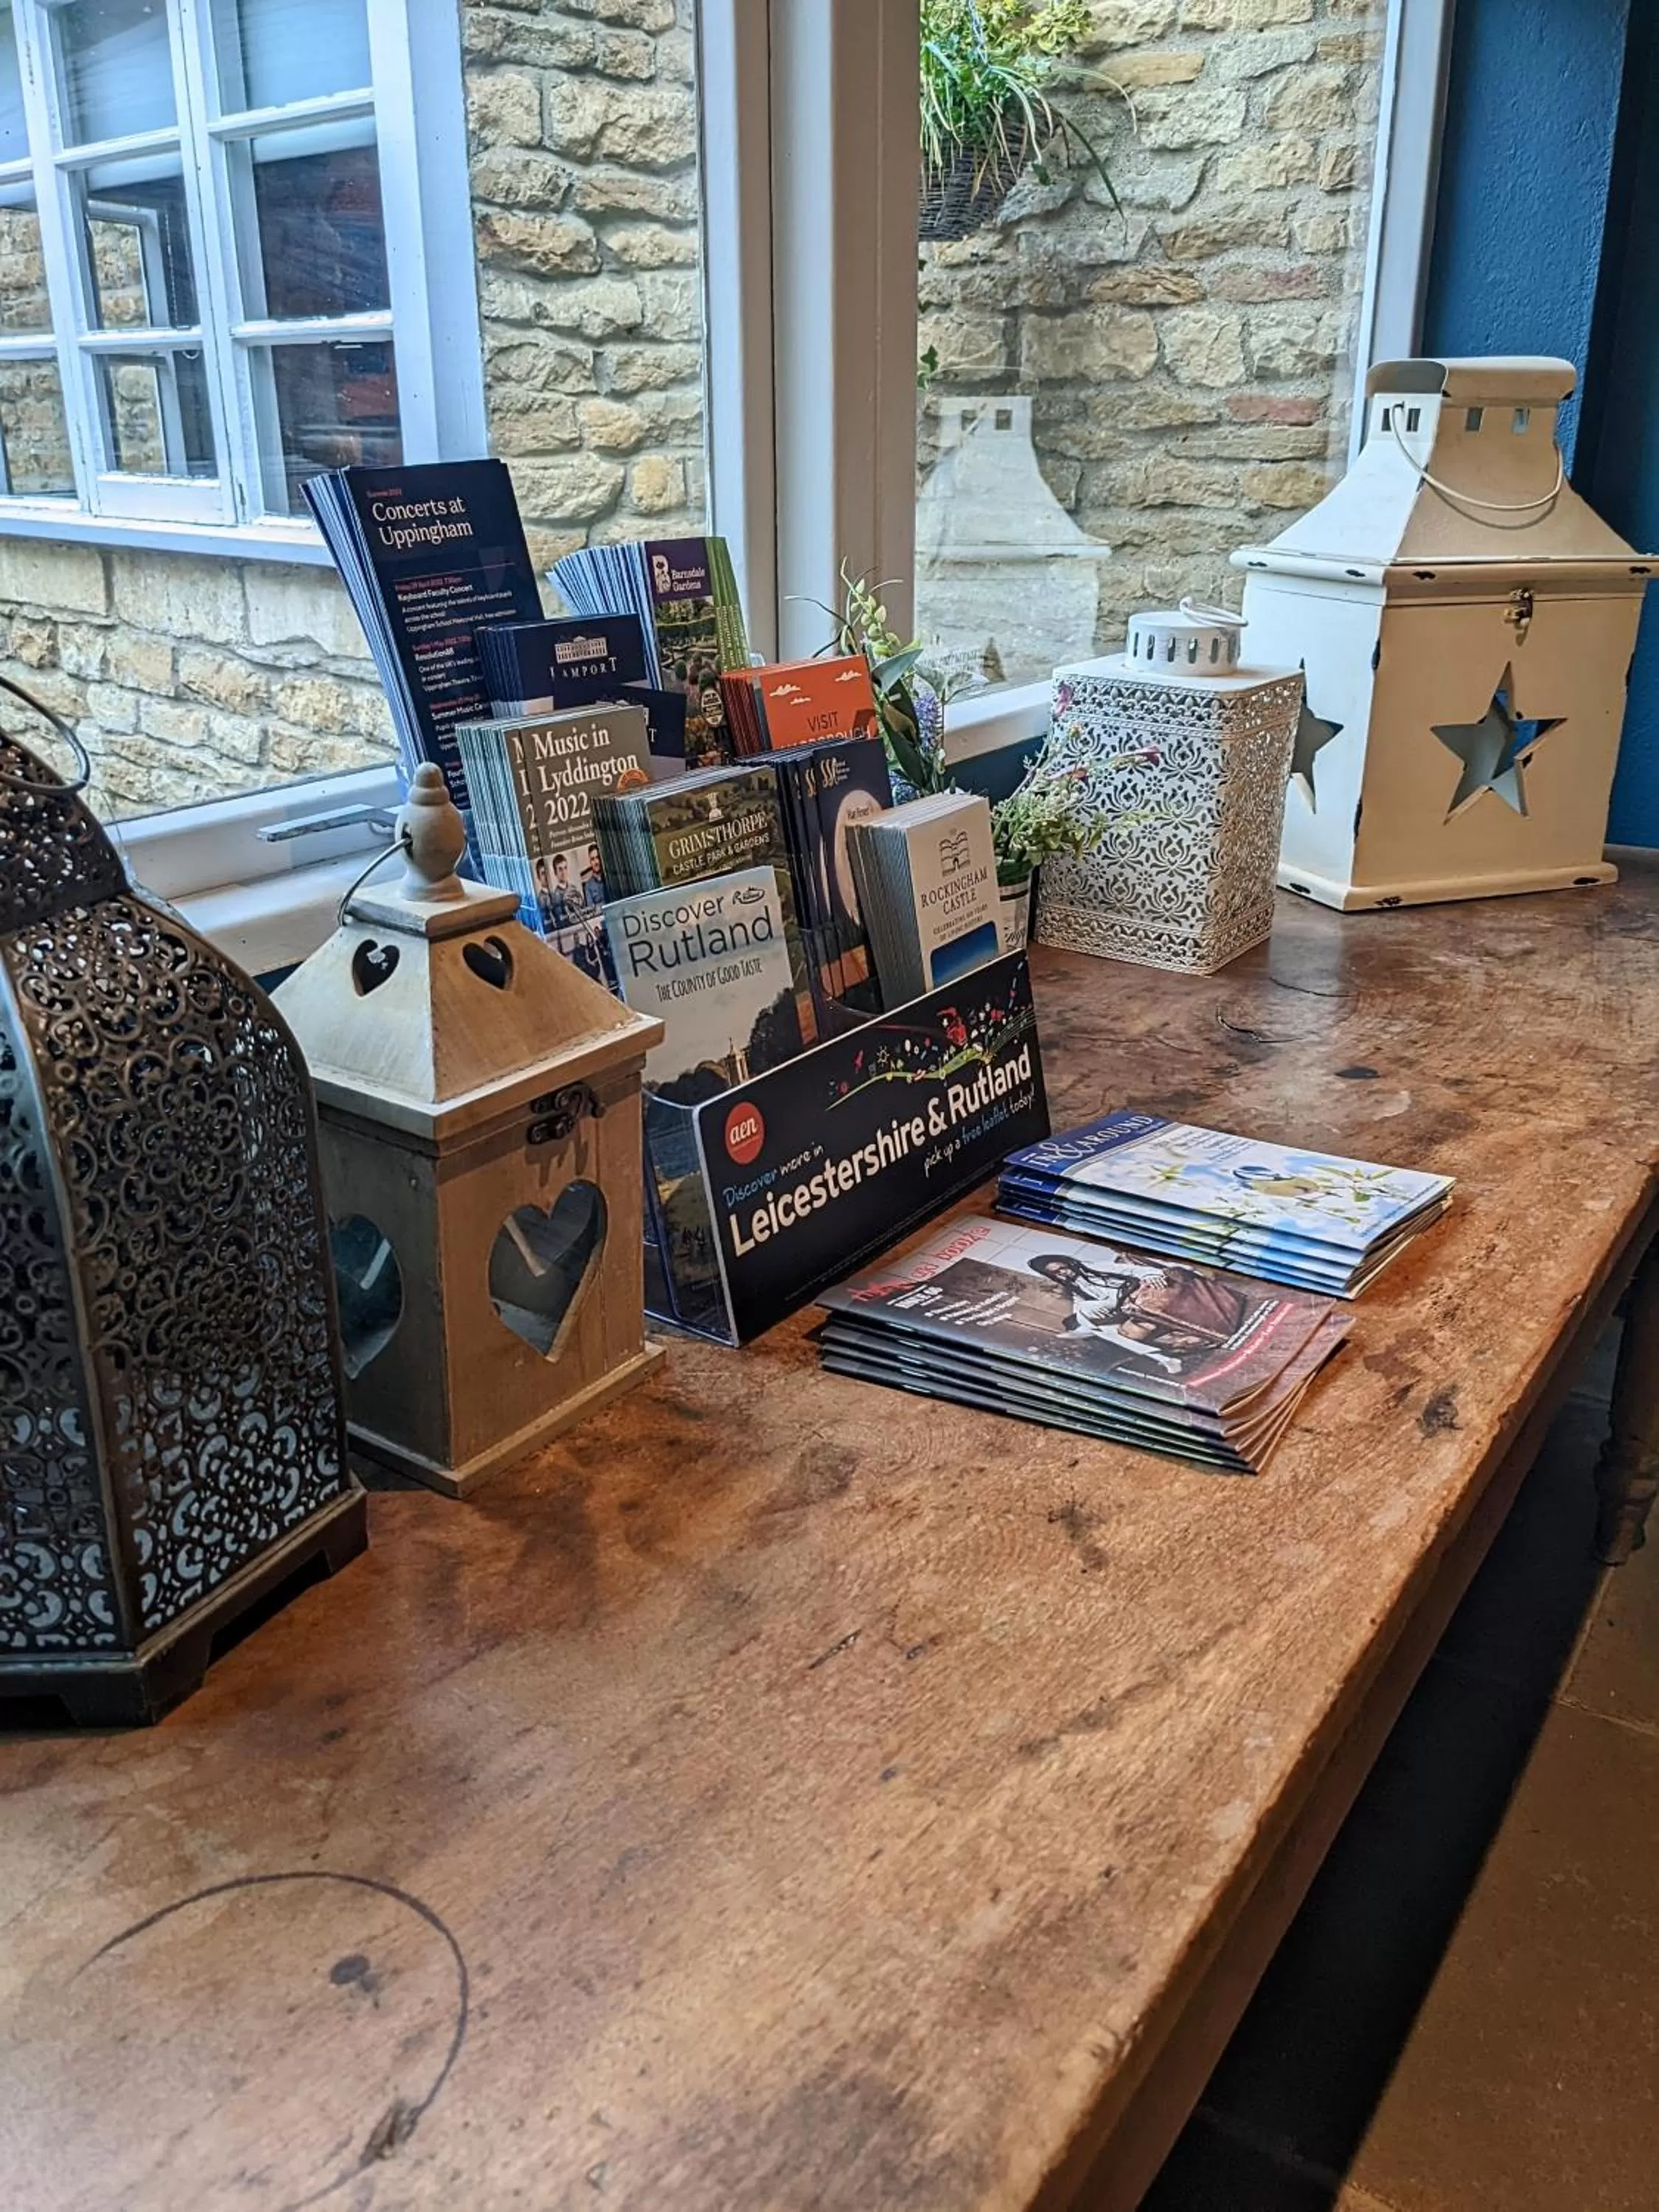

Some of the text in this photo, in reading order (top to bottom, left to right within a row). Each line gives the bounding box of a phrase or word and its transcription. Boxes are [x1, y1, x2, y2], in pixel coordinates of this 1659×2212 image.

[372, 496, 466, 521] Concerts at
[379, 520, 473, 549] Uppingham
[671, 567, 706, 580] Barnsdale
[672, 580, 701, 592] Gardens
[807, 711, 838, 732] VISIT
[532, 726, 588, 761] Music
[591, 723, 611, 747] in
[537, 754, 639, 798] Lyddington
[544, 791, 591, 825] 2022
[669, 811, 768, 859] GRIMSTHORPE
[706, 848, 726, 863] PARK
[734, 832, 771, 853] GARDENS
[921, 866, 988, 908] ROCKINGHAM
[944, 887, 977, 915] CASTLE
[623, 895, 725, 939] Discover
[628, 905, 773, 977] Rutland
[655, 983, 672, 1002] THE
[672, 975, 706, 998] COUNTY
[717, 964, 741, 984] GOOD
[740, 958, 763, 977] TASTE
[729, 1043, 1032, 1257] Leicestershire & Rutland
[1080, 1115, 1155, 1152] AROUND
[723, 1141, 824, 1208] Discover more in
[924, 1145, 943, 1178] pick
[944, 1142, 953, 1164] up
[955, 1139, 961, 1150] a
